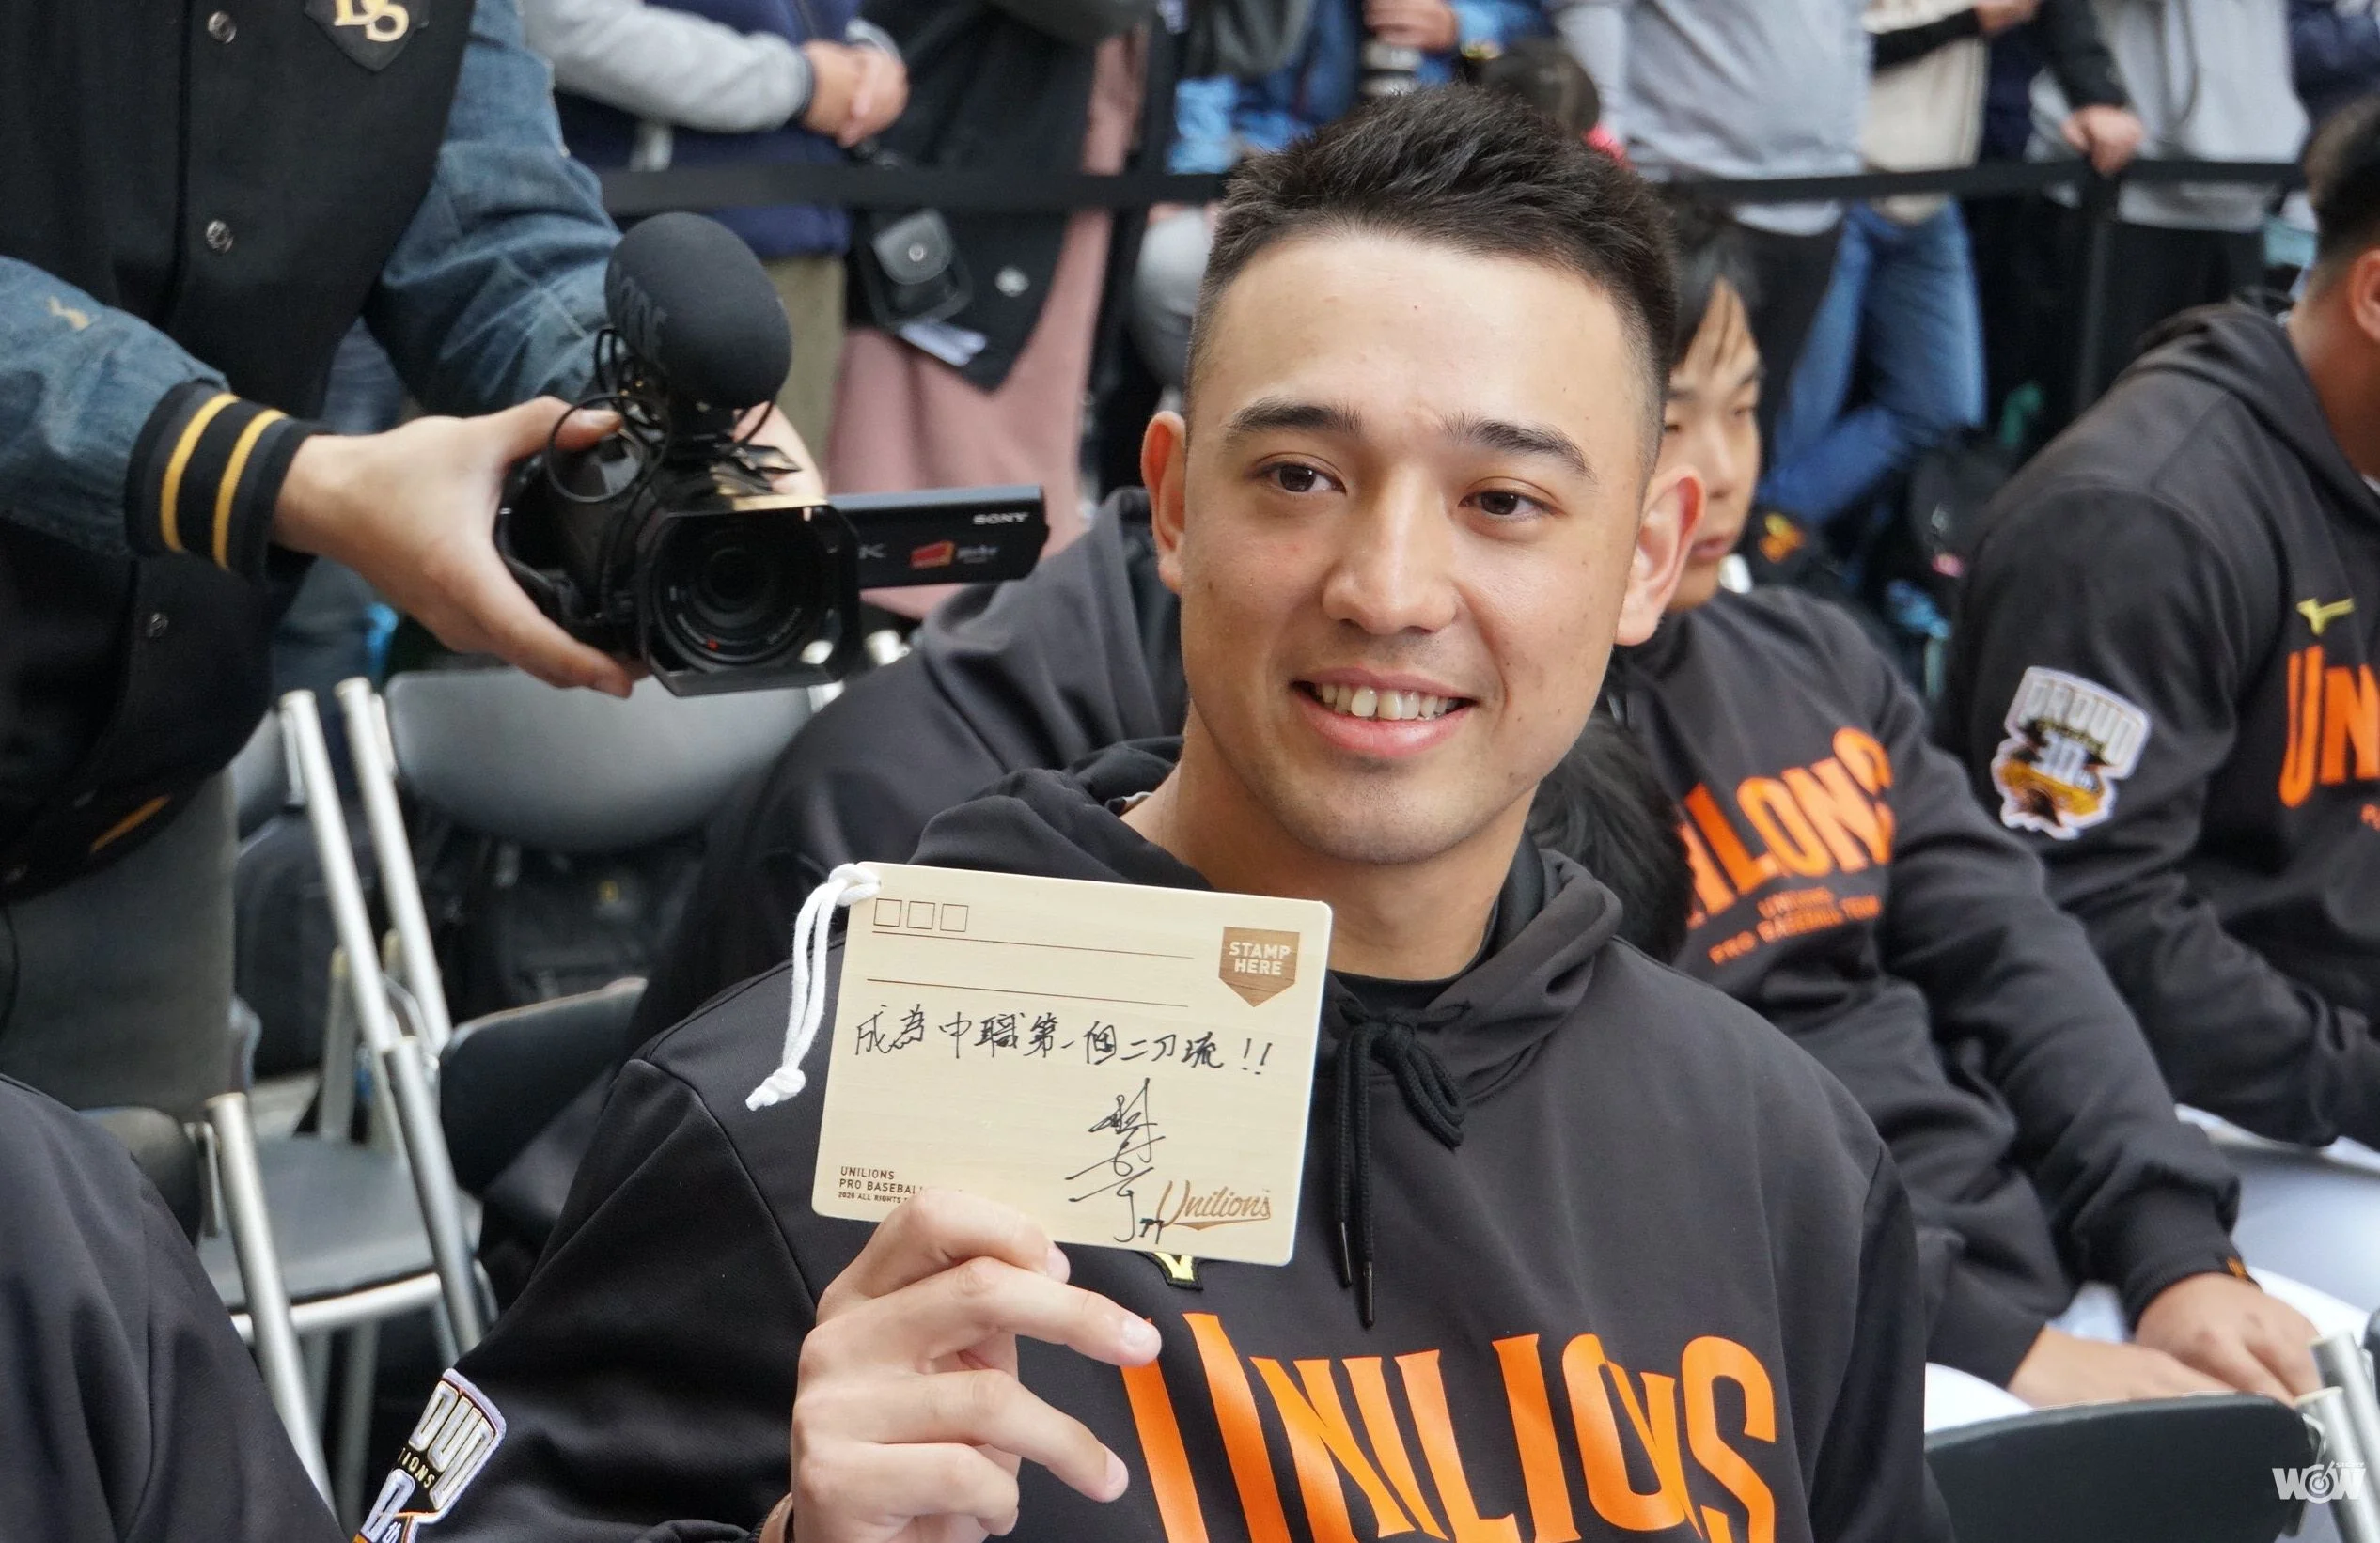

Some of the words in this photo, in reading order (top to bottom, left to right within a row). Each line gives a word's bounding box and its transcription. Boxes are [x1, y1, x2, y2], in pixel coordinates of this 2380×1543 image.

[972, 512, 1029, 525] SONY
[2018, 678, 2146, 766] PROUD
[1229, 941, 1292, 959] STAMP
[1234, 958, 1283, 975] HERE
[840, 1166, 895, 1180] UNILIONS
[838, 1178, 862, 1190] PRO
[838, 1191, 855, 1200] 2020
[873, 1195, 901, 1204] RIGHTS
[1155, 1179, 1271, 1229] Unilions
